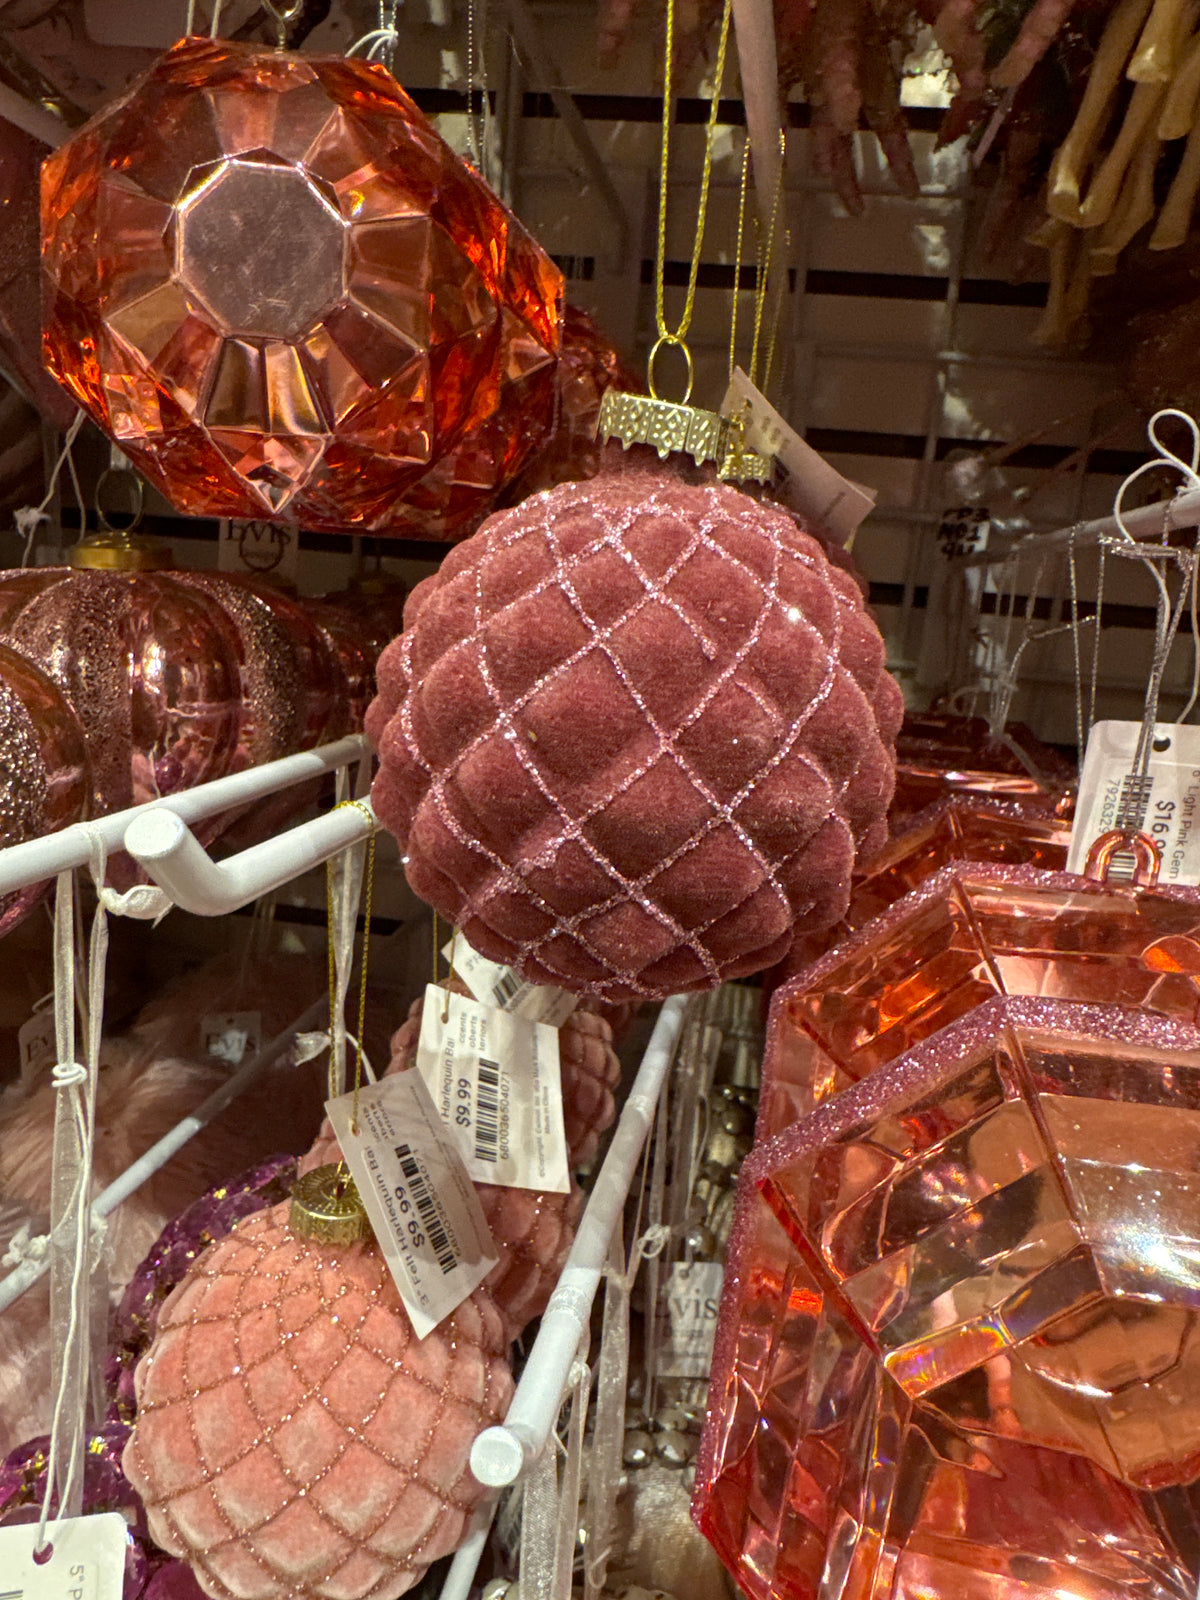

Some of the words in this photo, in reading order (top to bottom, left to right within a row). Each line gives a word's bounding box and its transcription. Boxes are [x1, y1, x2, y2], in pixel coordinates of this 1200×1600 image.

[1099, 779, 1121, 833] 7926329
[1183, 786, 1199, 816] Light
[1176, 820, 1192, 846] Pink
[1169, 850, 1184, 880] Gem
[440, 1059, 453, 1117] Harlequin
[456, 1078, 471, 1127] $9.99
[374, 1173, 408, 1250] Harlequin
[394, 1186, 424, 1248] $9.99
[405, 1254, 421, 1285] Felt
